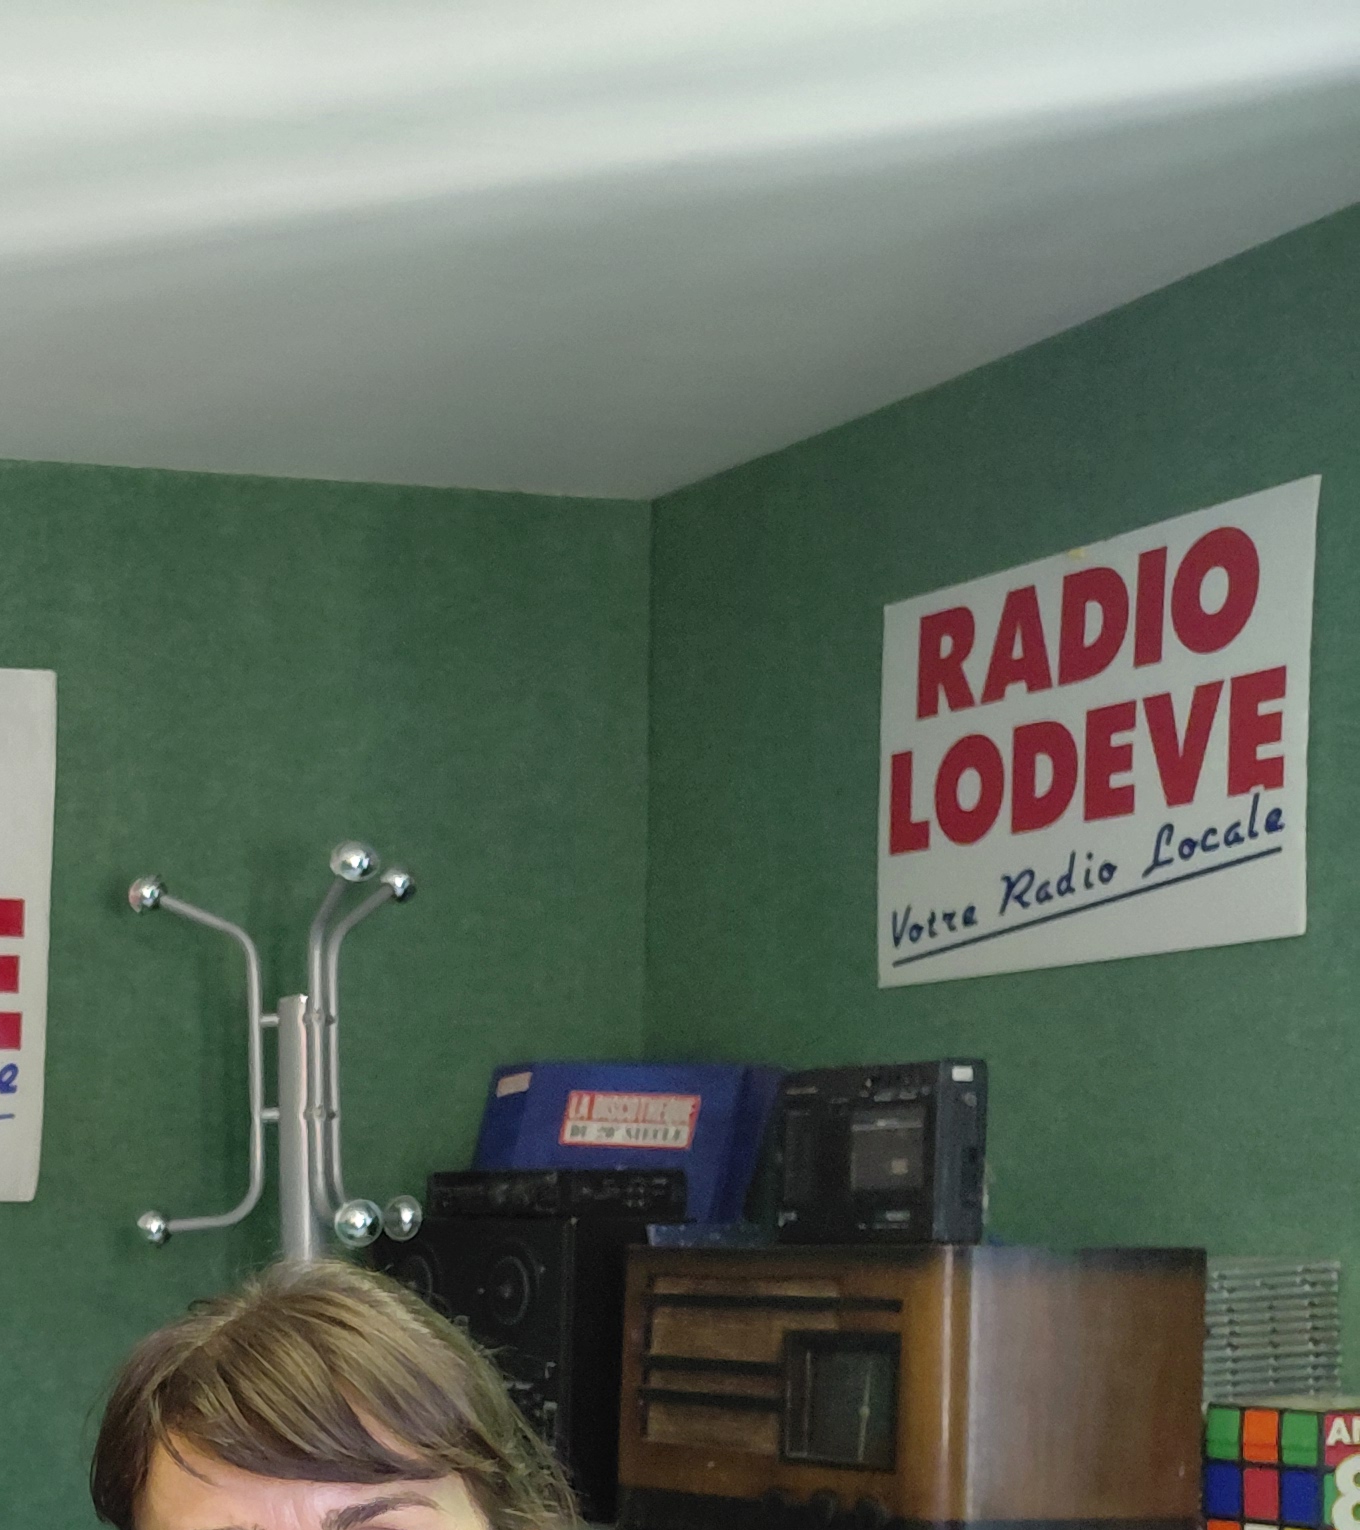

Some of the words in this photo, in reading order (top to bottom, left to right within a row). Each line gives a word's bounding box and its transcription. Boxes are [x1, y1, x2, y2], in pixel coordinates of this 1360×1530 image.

[916, 526, 1260, 720] RADIO
[889, 665, 1287, 856] LODEVE
[890, 904, 978, 949] Votre
[998, 850, 1118, 916] Radio
[1142, 793, 1285, 878] Locale
